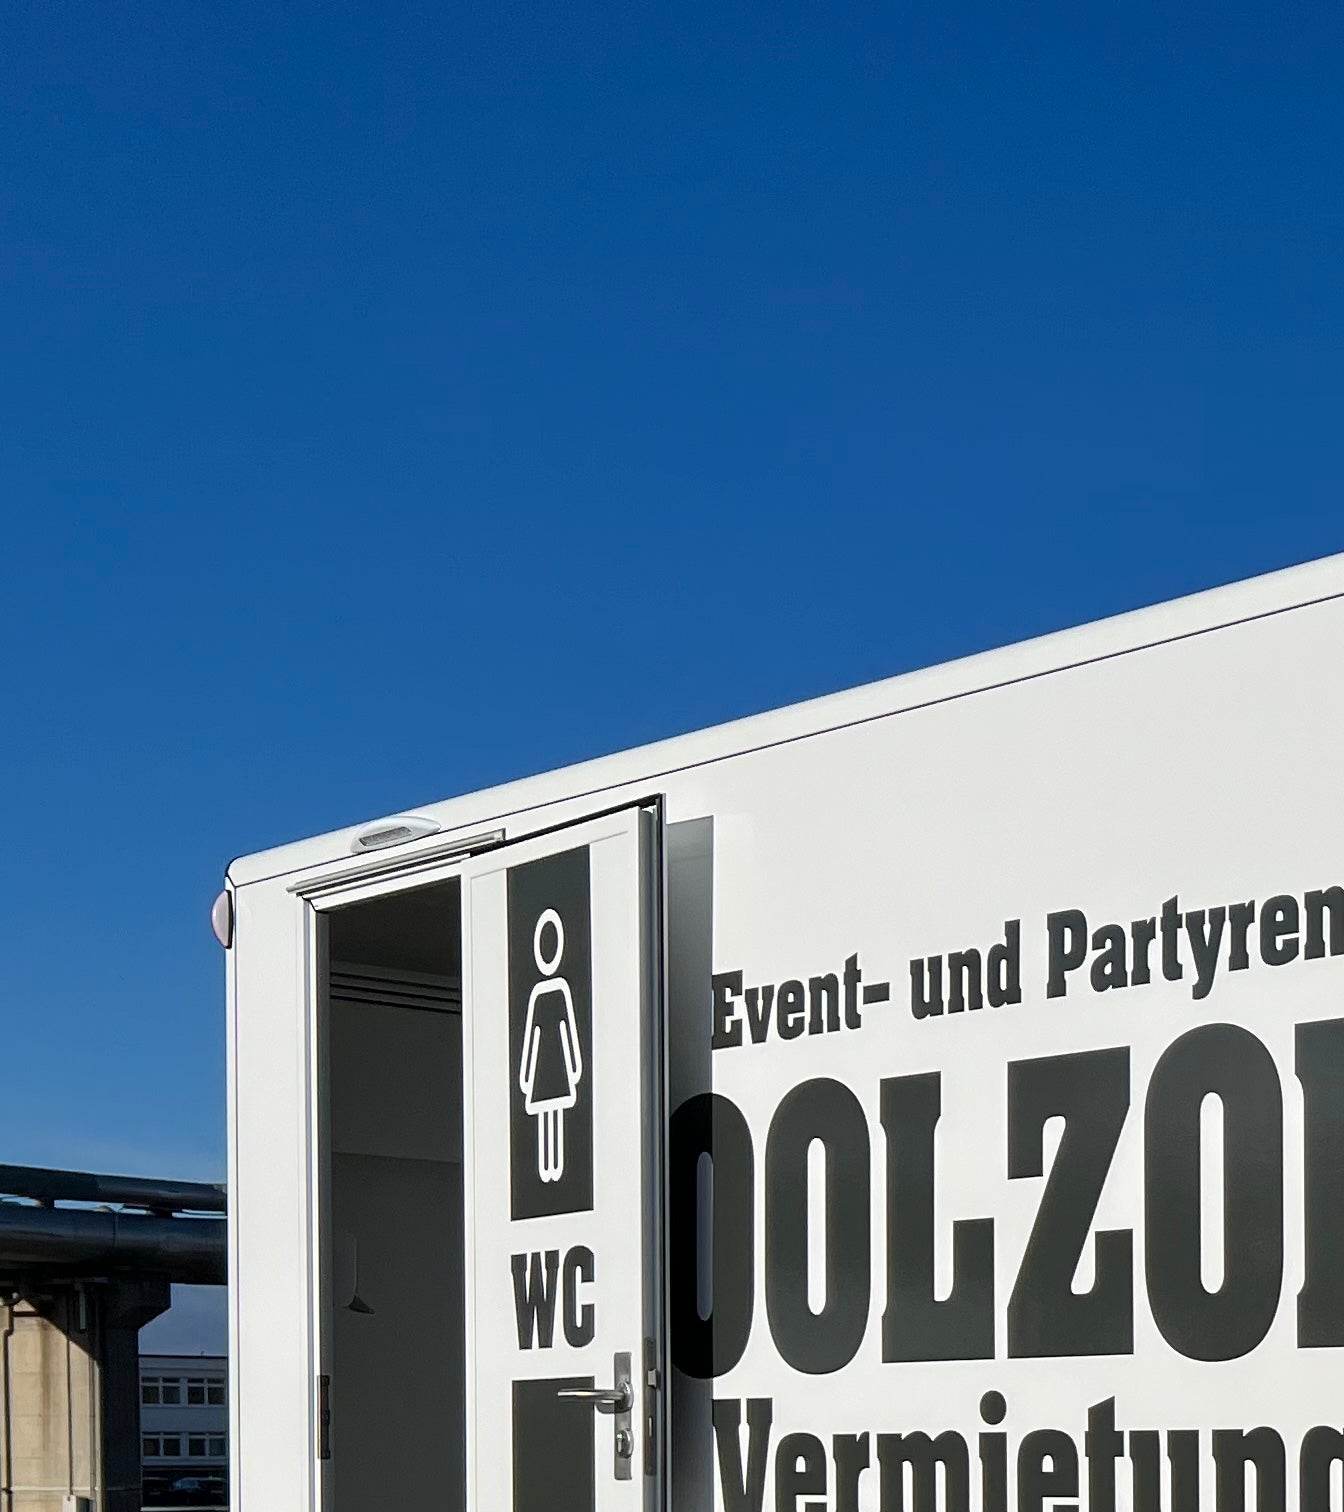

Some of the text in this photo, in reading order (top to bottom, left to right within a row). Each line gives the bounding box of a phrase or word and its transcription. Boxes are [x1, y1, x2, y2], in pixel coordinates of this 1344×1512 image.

[712, 951, 890, 1050] Event-
[909, 919, 1022, 1020] und
[511, 1245, 595, 1351] WC
